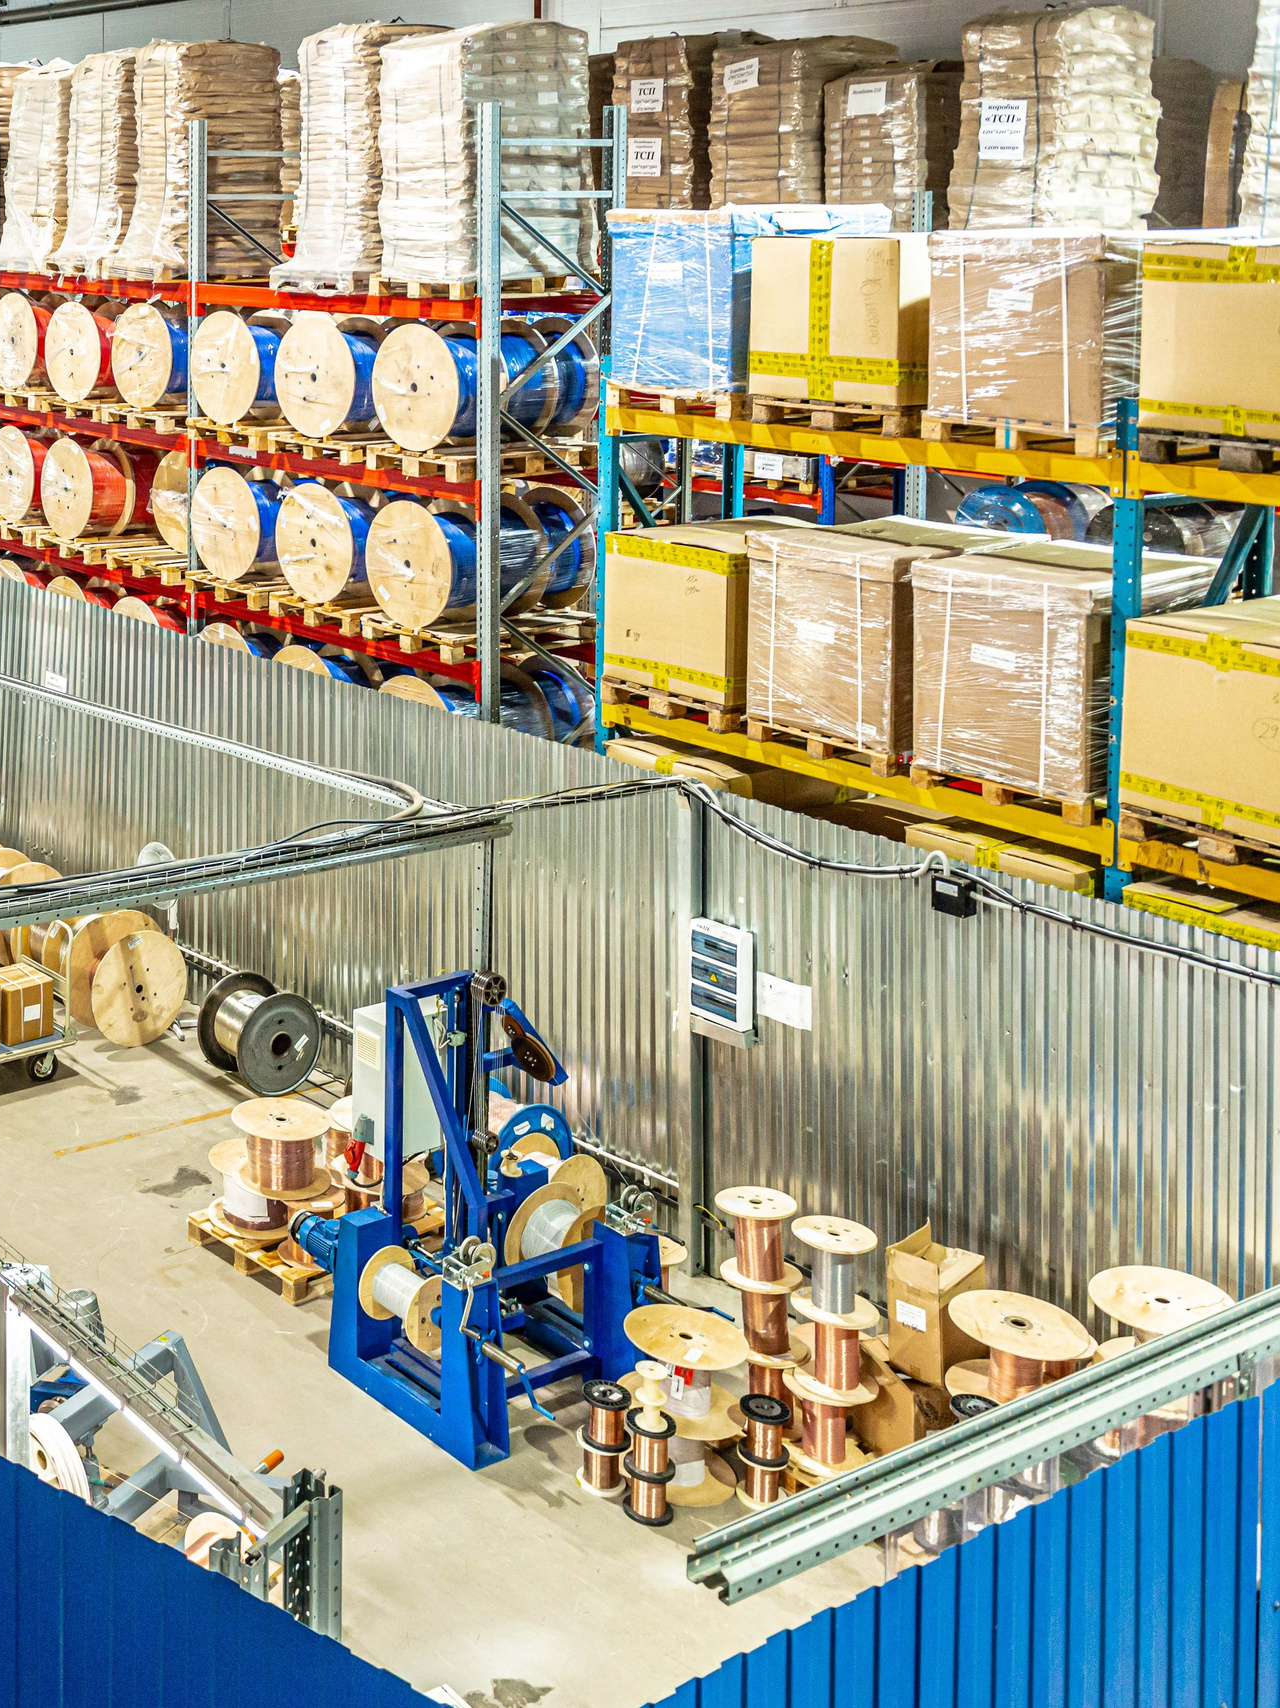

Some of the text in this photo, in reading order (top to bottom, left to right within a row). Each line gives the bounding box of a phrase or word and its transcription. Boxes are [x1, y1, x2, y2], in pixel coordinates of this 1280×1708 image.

[637, 87, 656, 96] ТСП
[984, 114, 1022, 123] «ТСП»
[633, 151, 655, 160] ТСП
